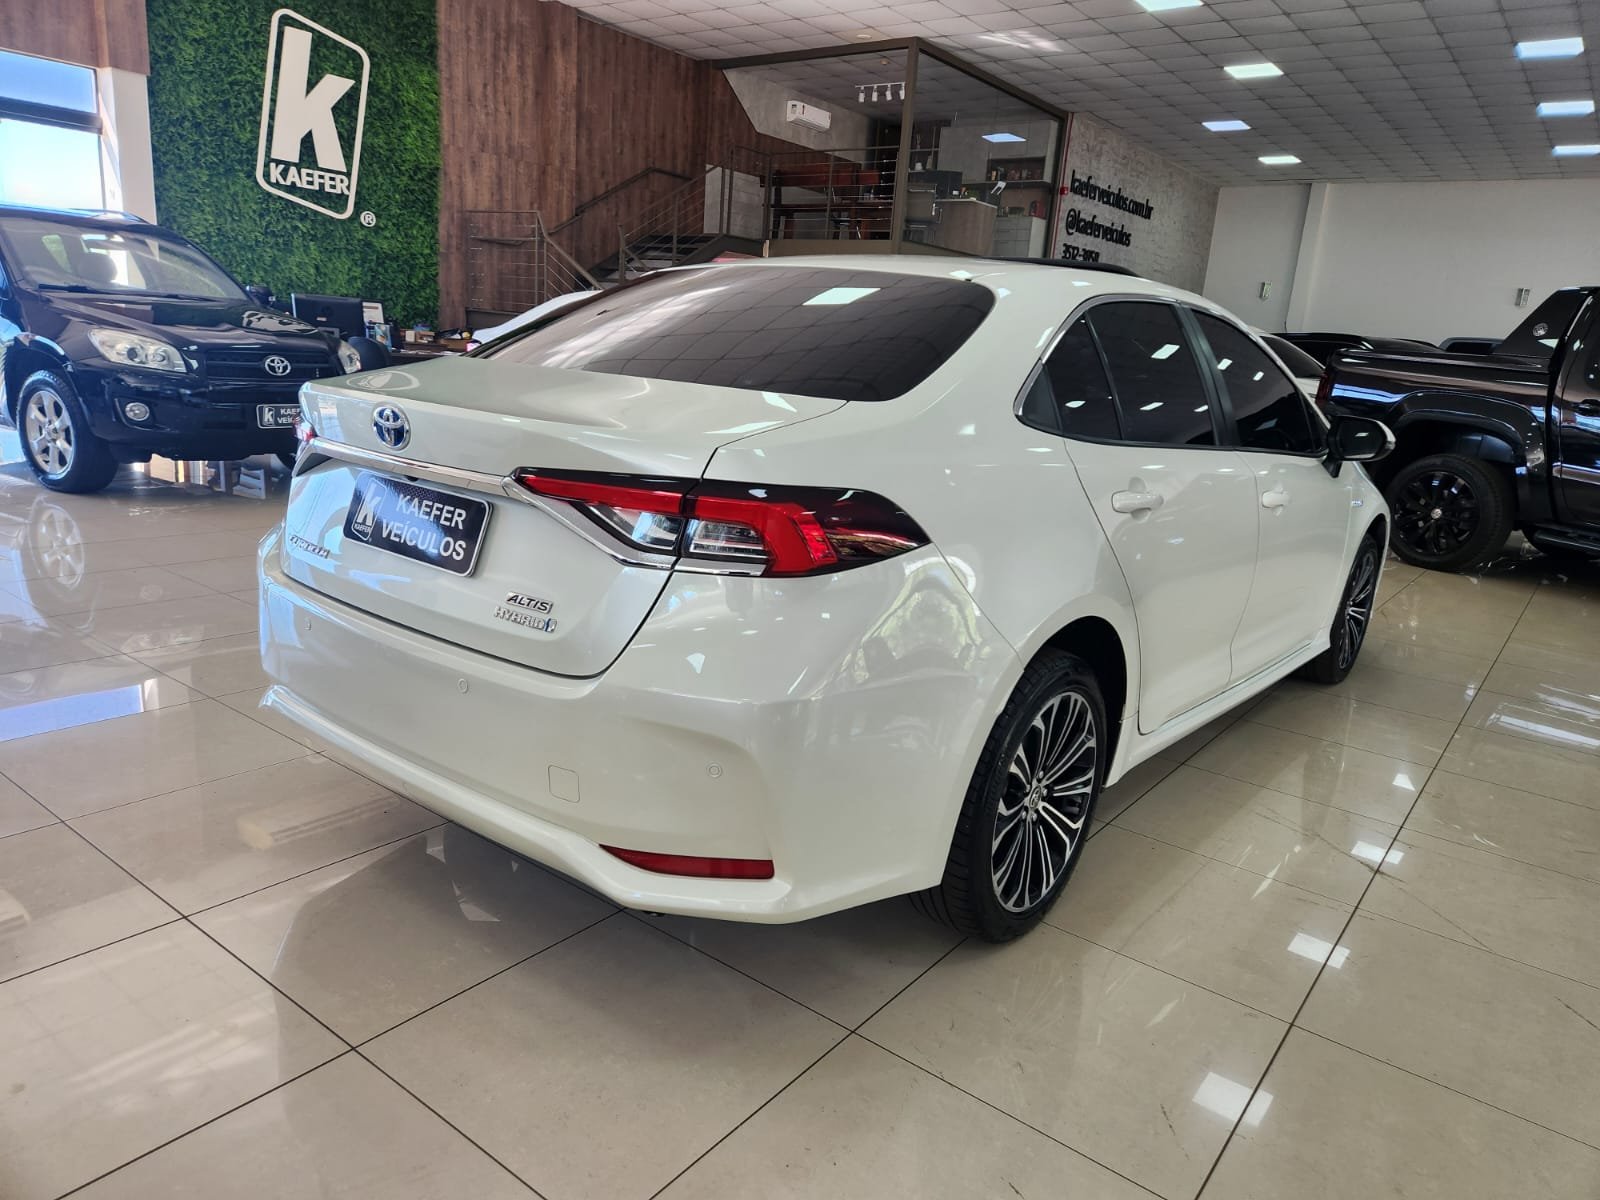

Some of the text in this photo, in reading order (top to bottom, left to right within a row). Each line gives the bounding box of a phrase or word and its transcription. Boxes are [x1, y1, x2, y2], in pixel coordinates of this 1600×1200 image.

[269, 162, 350, 195] KAEFER
[1069, 168, 1154, 220] kaeferveiculos.com.br
[1065, 208, 1132, 247] @kaeferveiculos
[396, 493, 467, 530] KAEFER
[381, 518, 467, 561] VEÍCULOS
[506, 593, 551, 612] ALTIS
